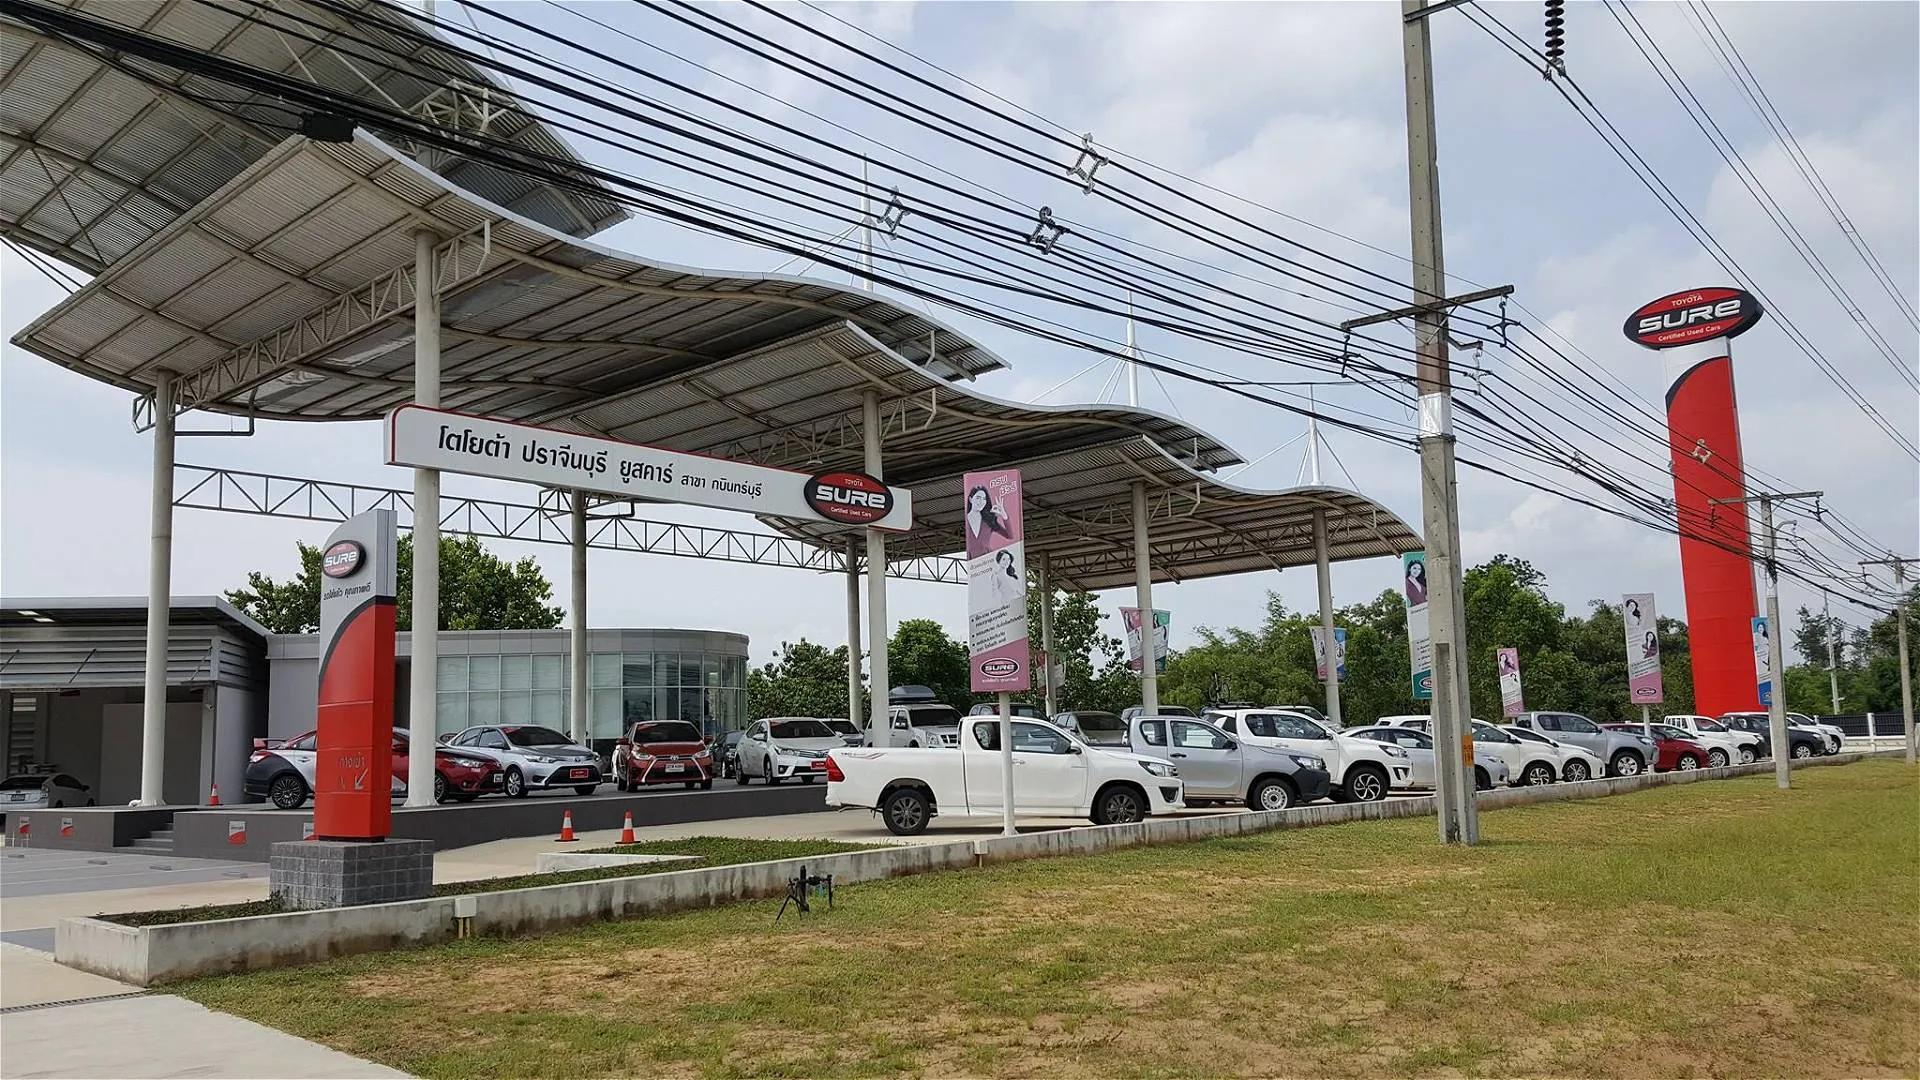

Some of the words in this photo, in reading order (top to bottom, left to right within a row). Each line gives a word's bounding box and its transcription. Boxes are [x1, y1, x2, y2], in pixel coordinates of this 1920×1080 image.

[1671, 295, 1703, 306] TOYOTA
[1638, 299, 1741, 334] SURE
[1658, 331, 1685, 341] Certified
[1687, 328, 1704, 336] Used
[1706, 325, 1721, 333] Cars
[438, 425, 511, 459] โตโยต้า
[522, 440, 608, 478] ปราจีนบุรี
[620, 460, 674, 484] ยูสคาร์
[681, 474, 706, 488] สาขา
[711, 477, 762, 499] กบินทร์บุรี
[844, 478, 863, 487] TOYOTA
[816, 485, 886, 508] SURE
[325, 552, 357, 567] SURE
